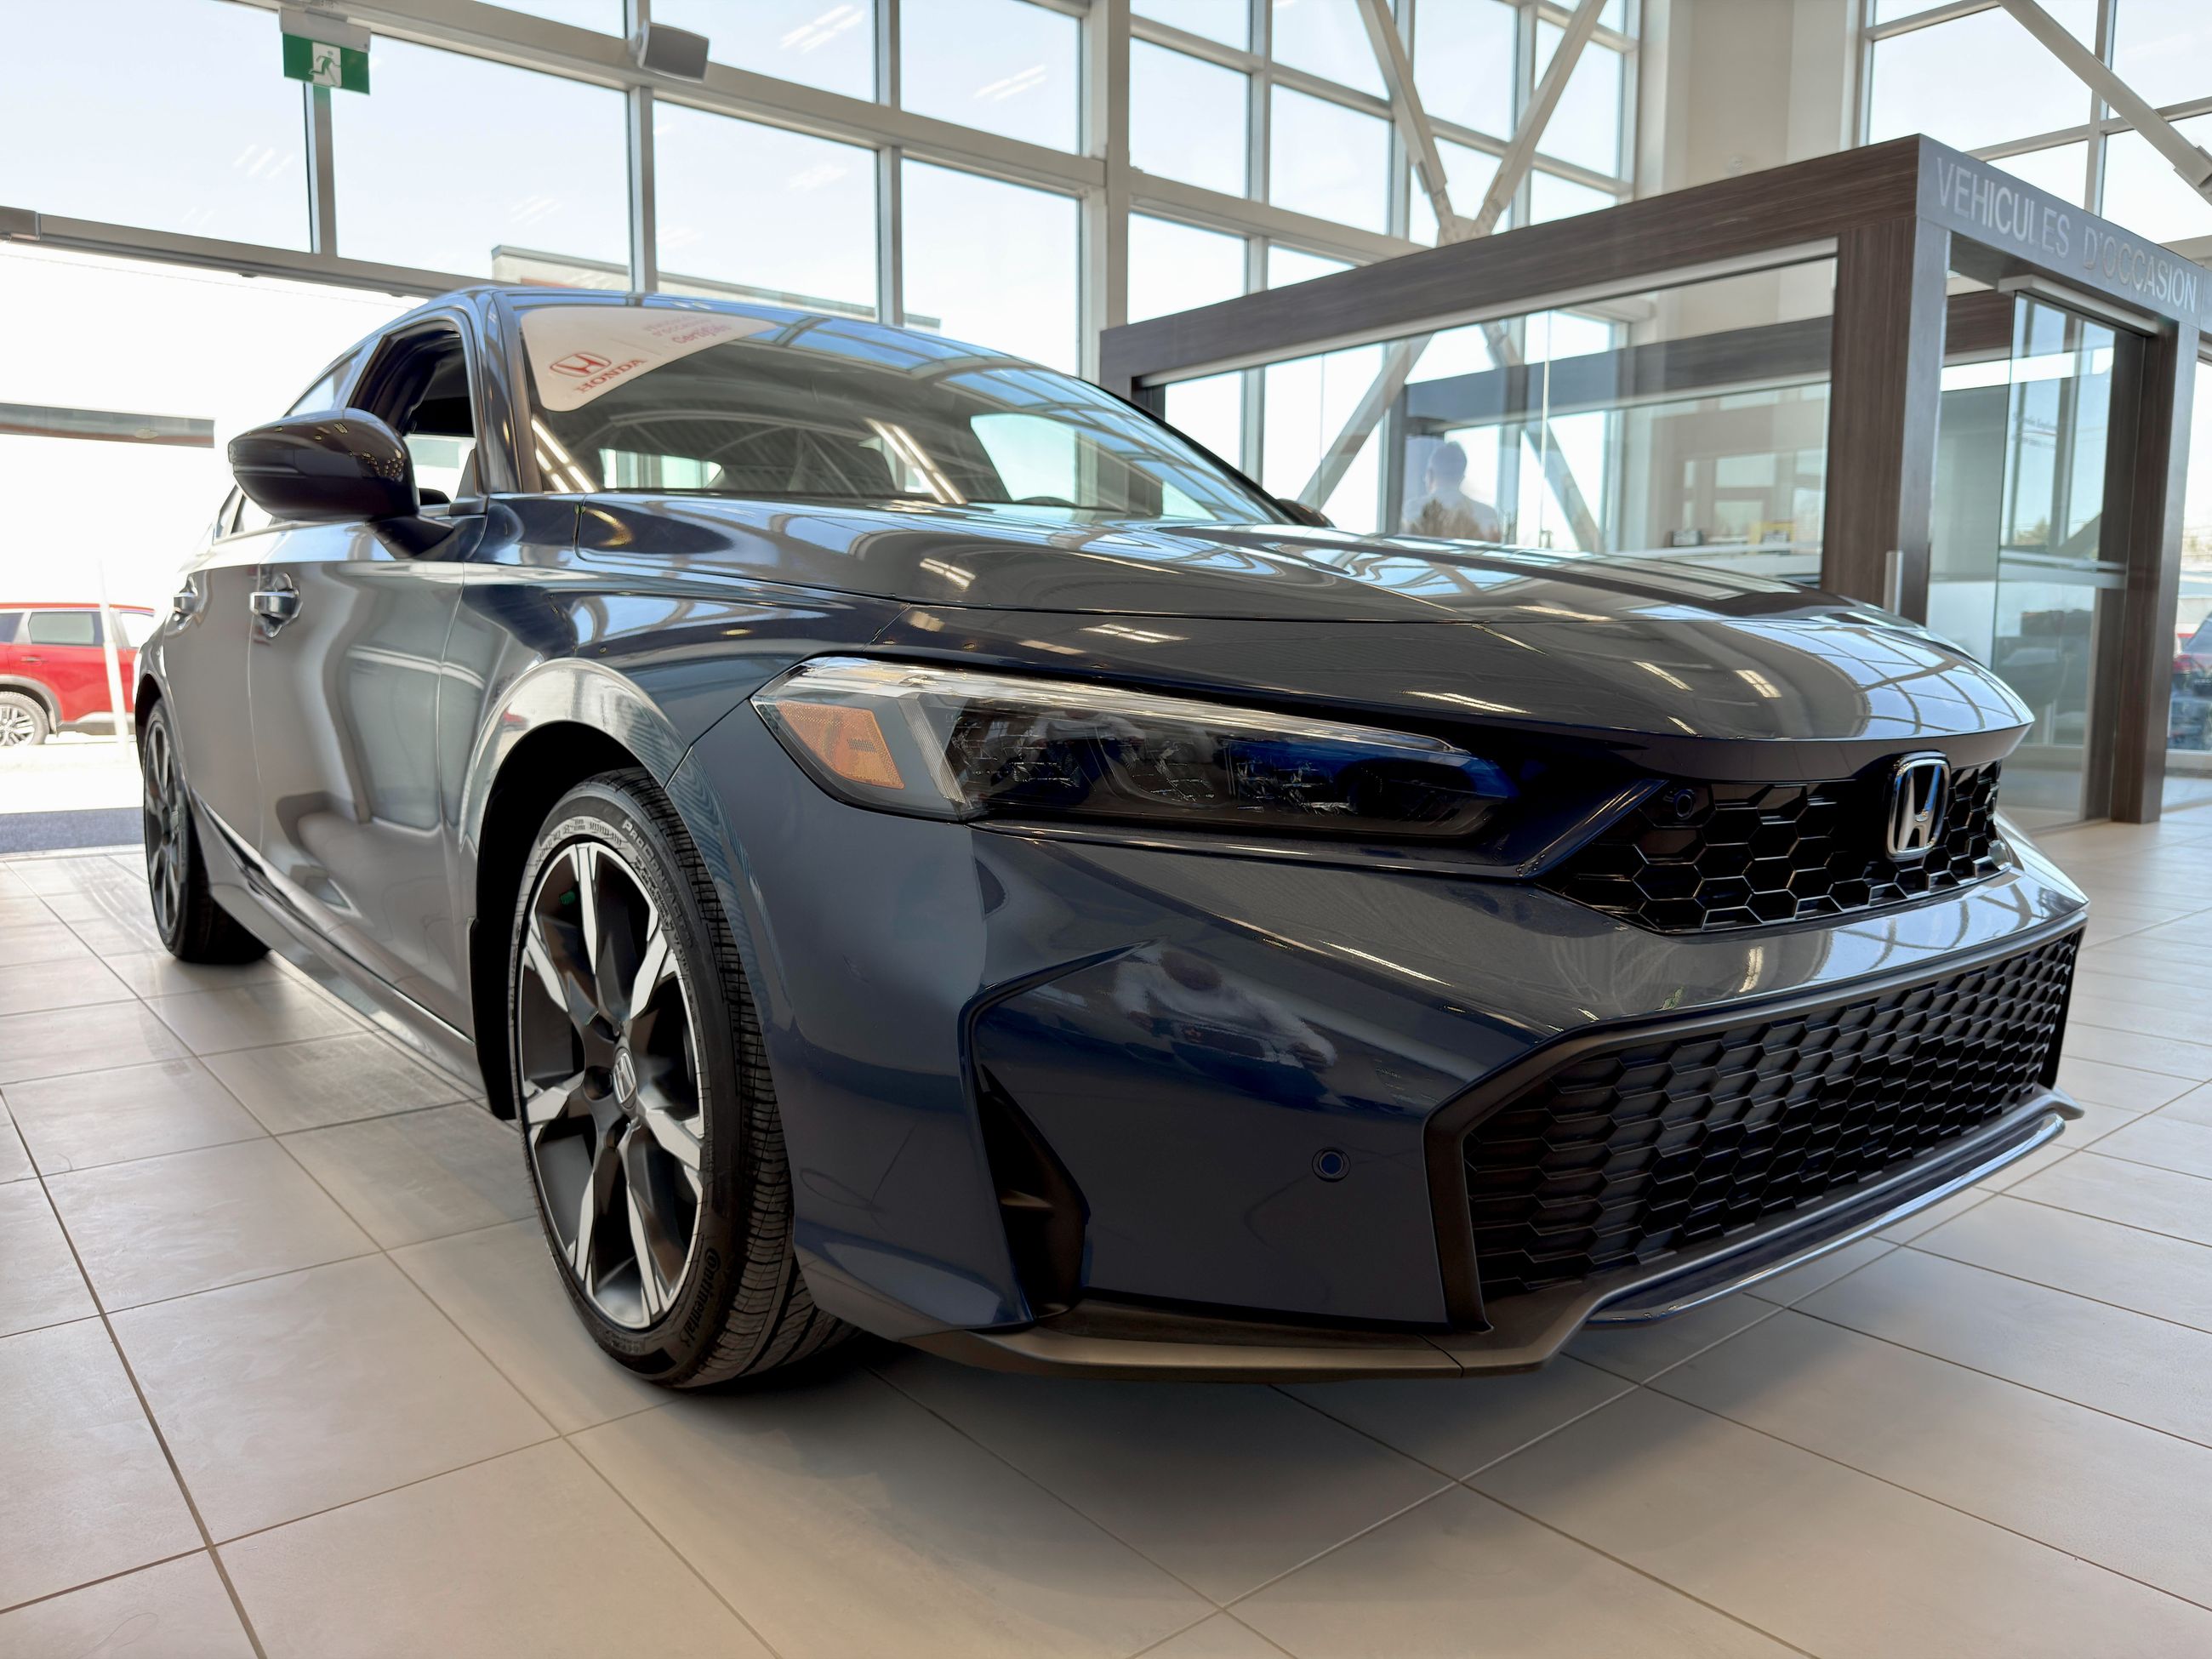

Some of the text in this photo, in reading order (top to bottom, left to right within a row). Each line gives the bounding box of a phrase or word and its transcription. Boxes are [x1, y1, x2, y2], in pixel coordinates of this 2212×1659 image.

[1936, 157, 2198, 314] VEHICULES D'OCCASION
[573, 359, 647, 393] HONDA
[682, 1247, 721, 1342] Continental
